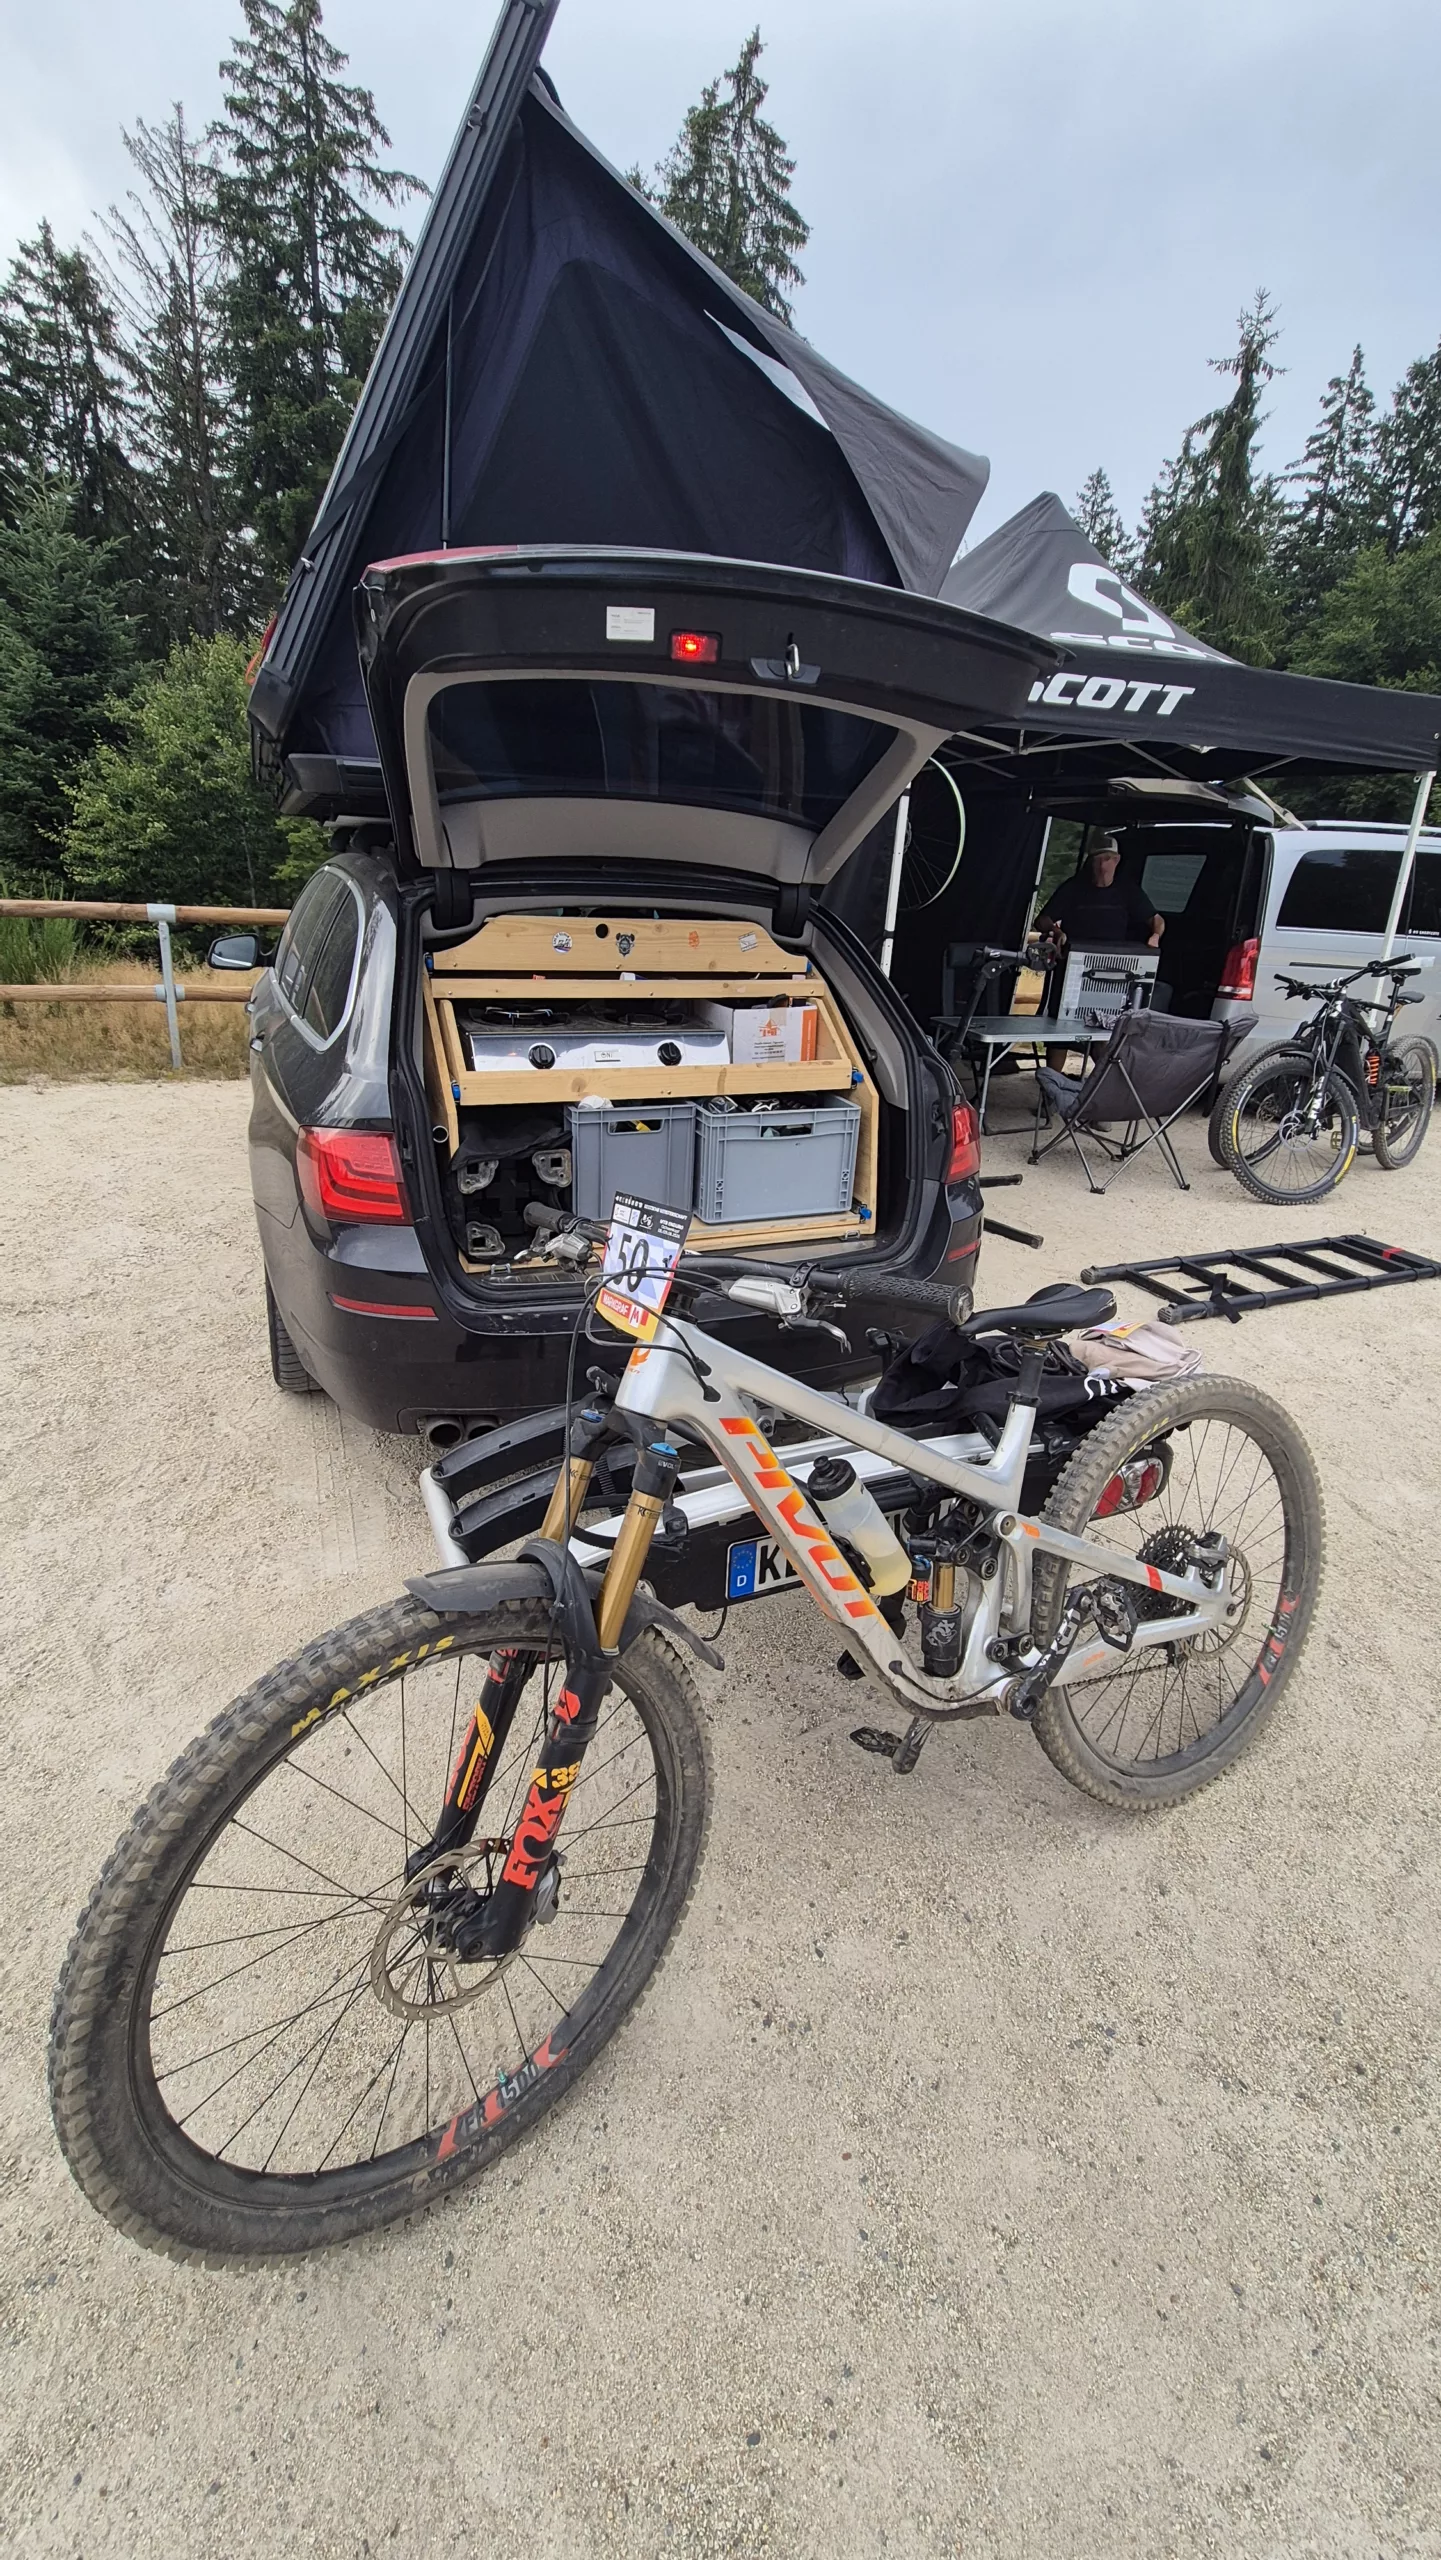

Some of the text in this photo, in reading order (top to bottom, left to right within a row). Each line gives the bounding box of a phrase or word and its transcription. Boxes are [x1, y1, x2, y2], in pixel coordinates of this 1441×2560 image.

[613, 1233, 649, 1293] 50
[718, 1416, 890, 1632] PIVOT
[736, 1574, 747, 1588] D
[291, 1635, 456, 1738] MAXXIS
[503, 1783, 565, 1890] FOX
